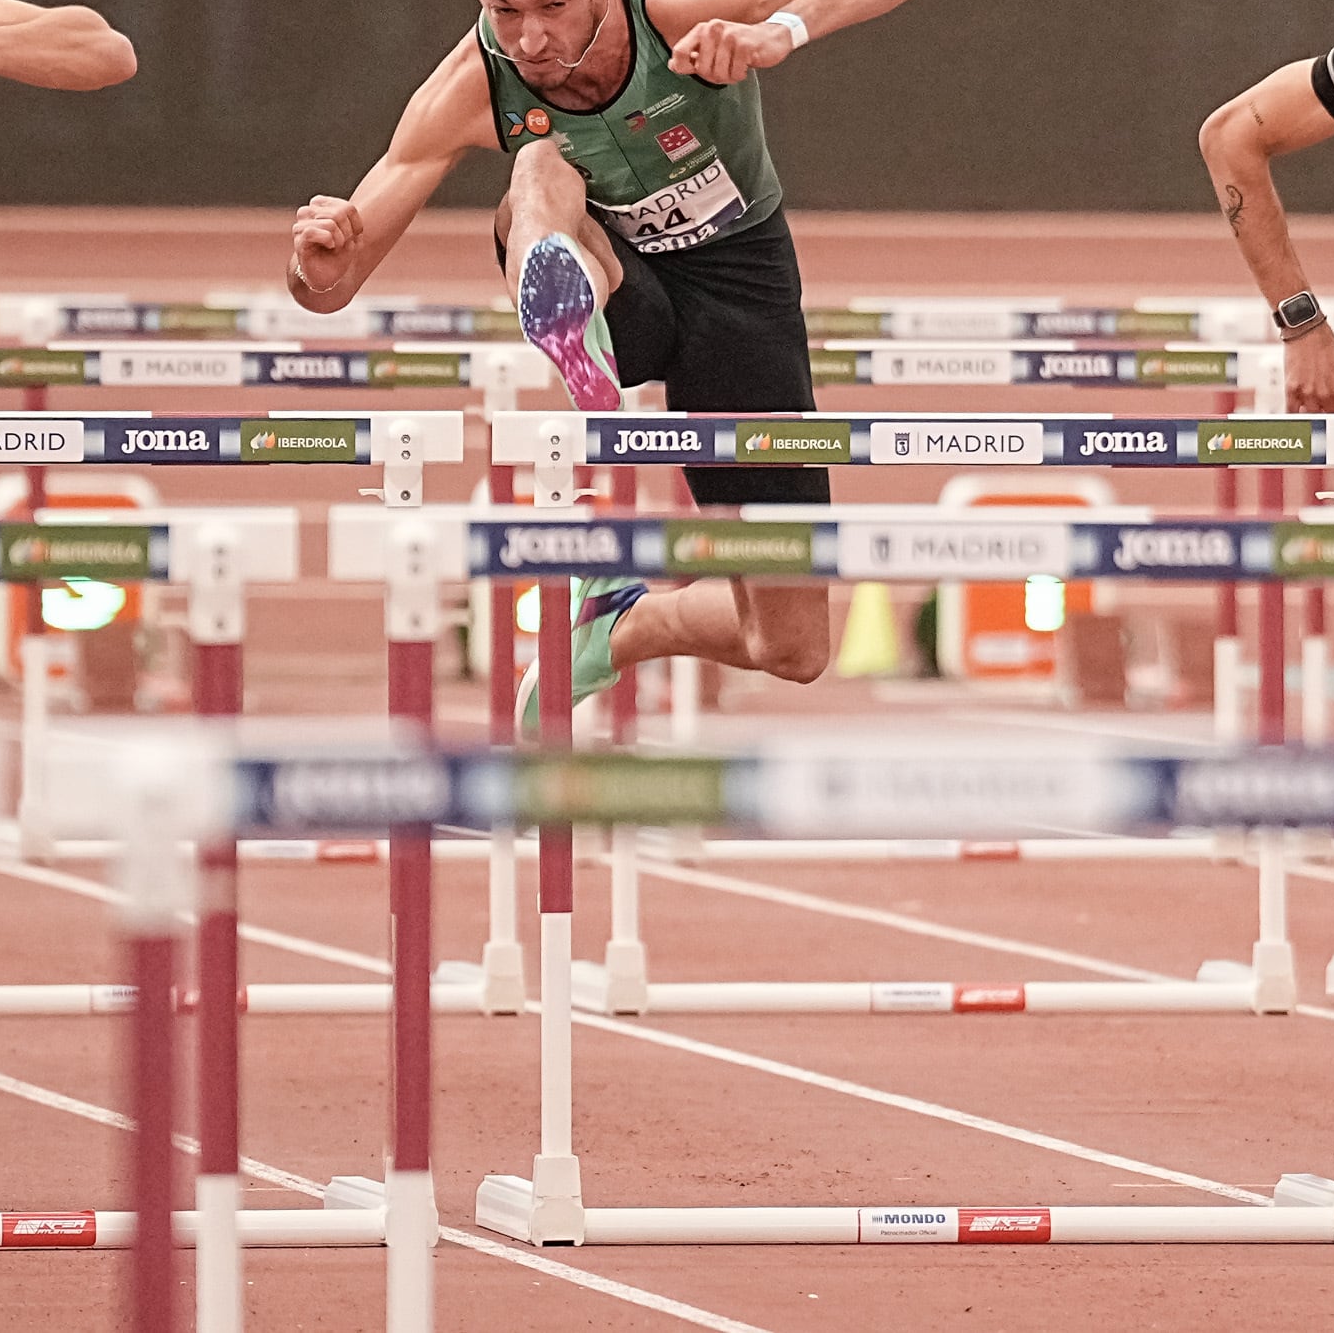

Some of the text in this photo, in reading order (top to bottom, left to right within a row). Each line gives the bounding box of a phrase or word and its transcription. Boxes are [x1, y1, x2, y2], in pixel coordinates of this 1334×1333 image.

[638, 223, 718, 254] oma
[121, 429, 210, 454] Joma
[277, 437, 348, 448] IBERDROLA
[613, 429, 702, 454] Joma
[772, 438, 842, 450] IBERDROLA
[926, 434, 1025, 453] MADRID
[1079, 429, 1168, 455] Joma
[1234, 437, 1304, 450] IBERDROLA
[884, 1213, 946, 1224] MONDO
